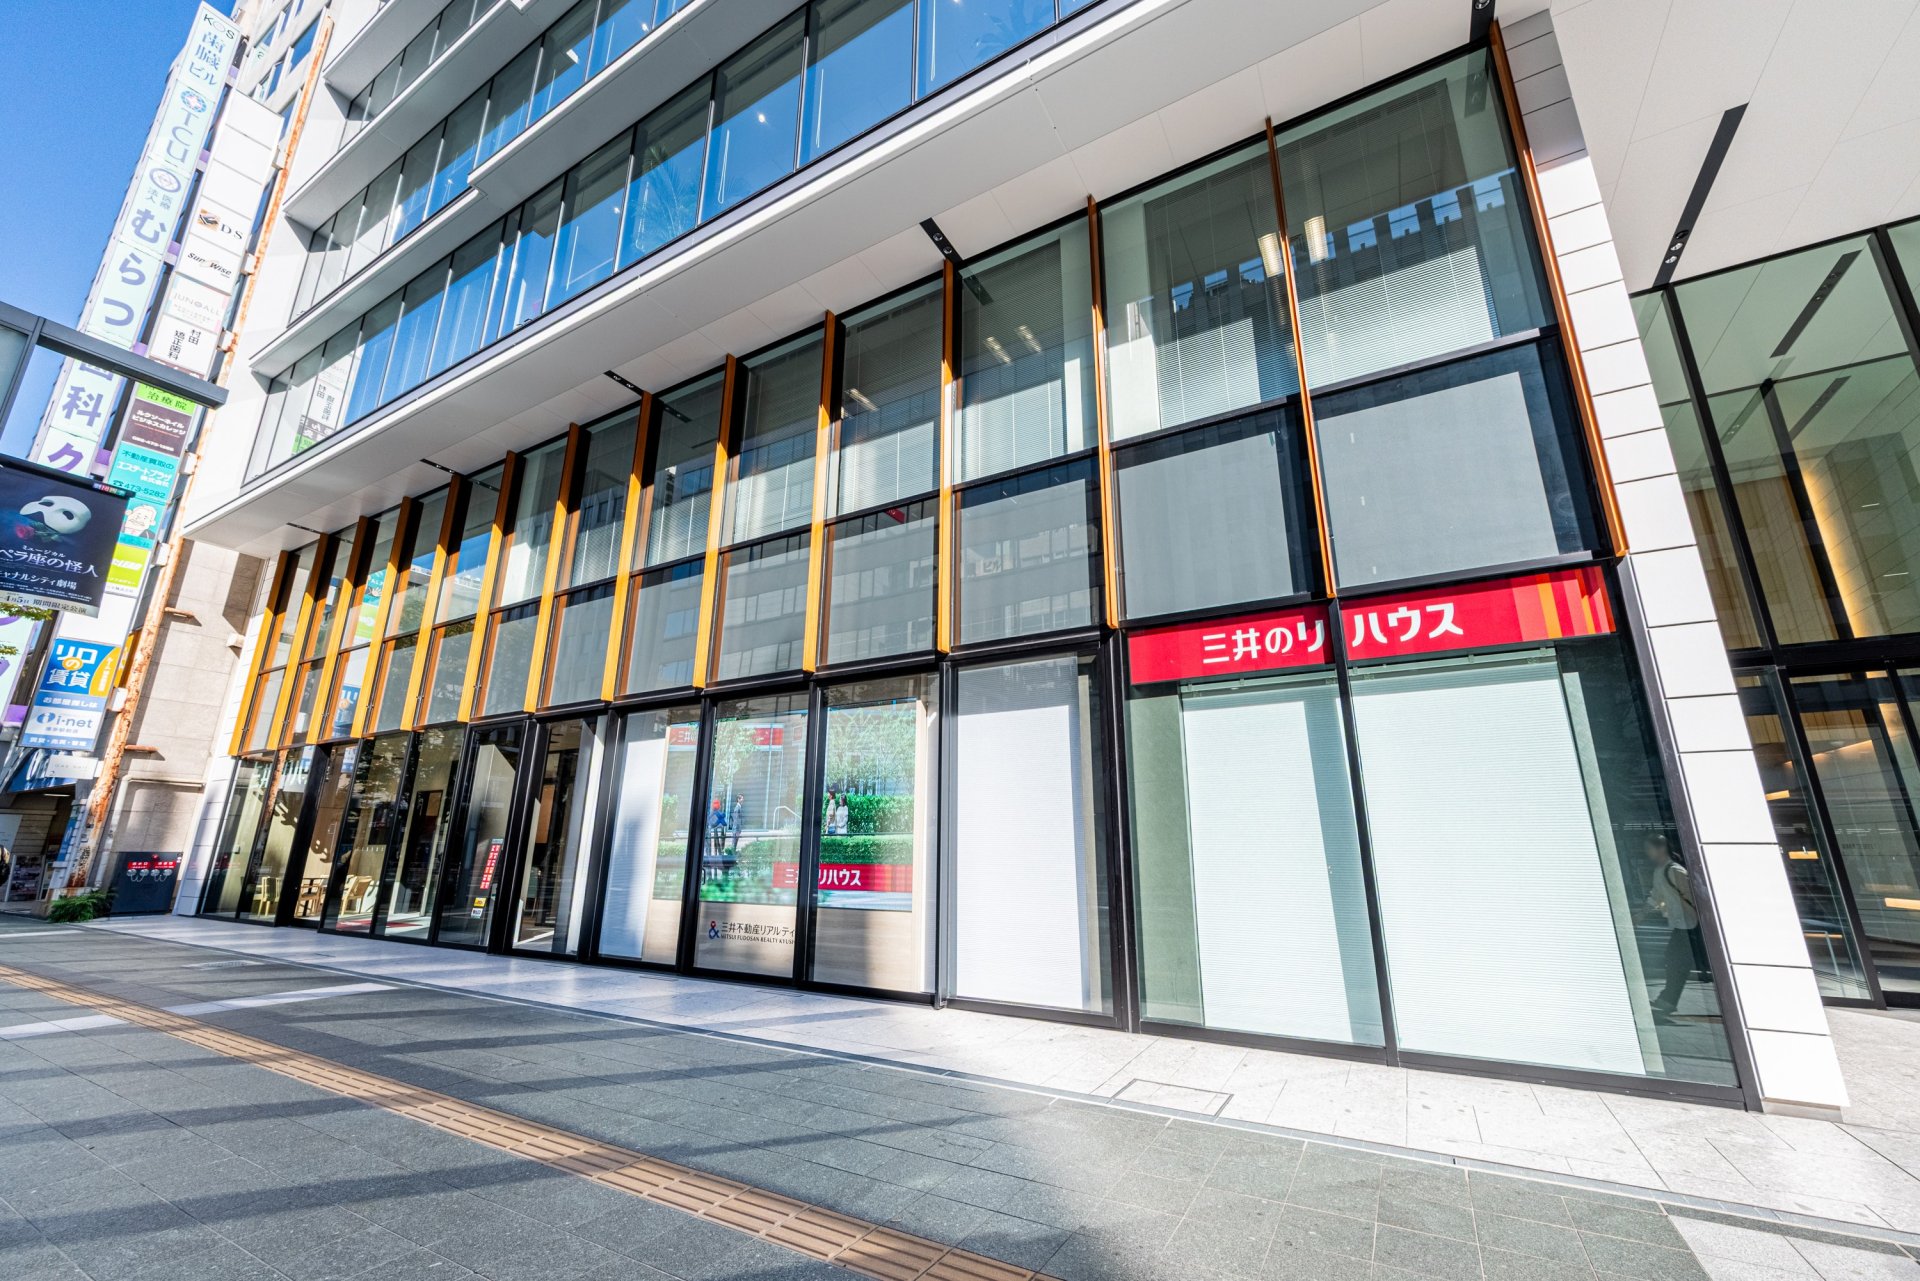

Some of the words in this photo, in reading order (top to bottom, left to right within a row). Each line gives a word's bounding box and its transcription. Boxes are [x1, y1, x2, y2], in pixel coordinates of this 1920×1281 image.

[166, 108, 199, 164] TCU
[188, 252, 206, 263] Sun
[210, 262, 232, 276] Wise
[147, 391, 187, 411] 治療院
[124, 482, 166, 499] 473-5282
[22, 544, 67, 558] ミュージカル
[1202, 602, 1463, 664] 三井のリハウス
[46, 668, 91, 689] 賃貸
